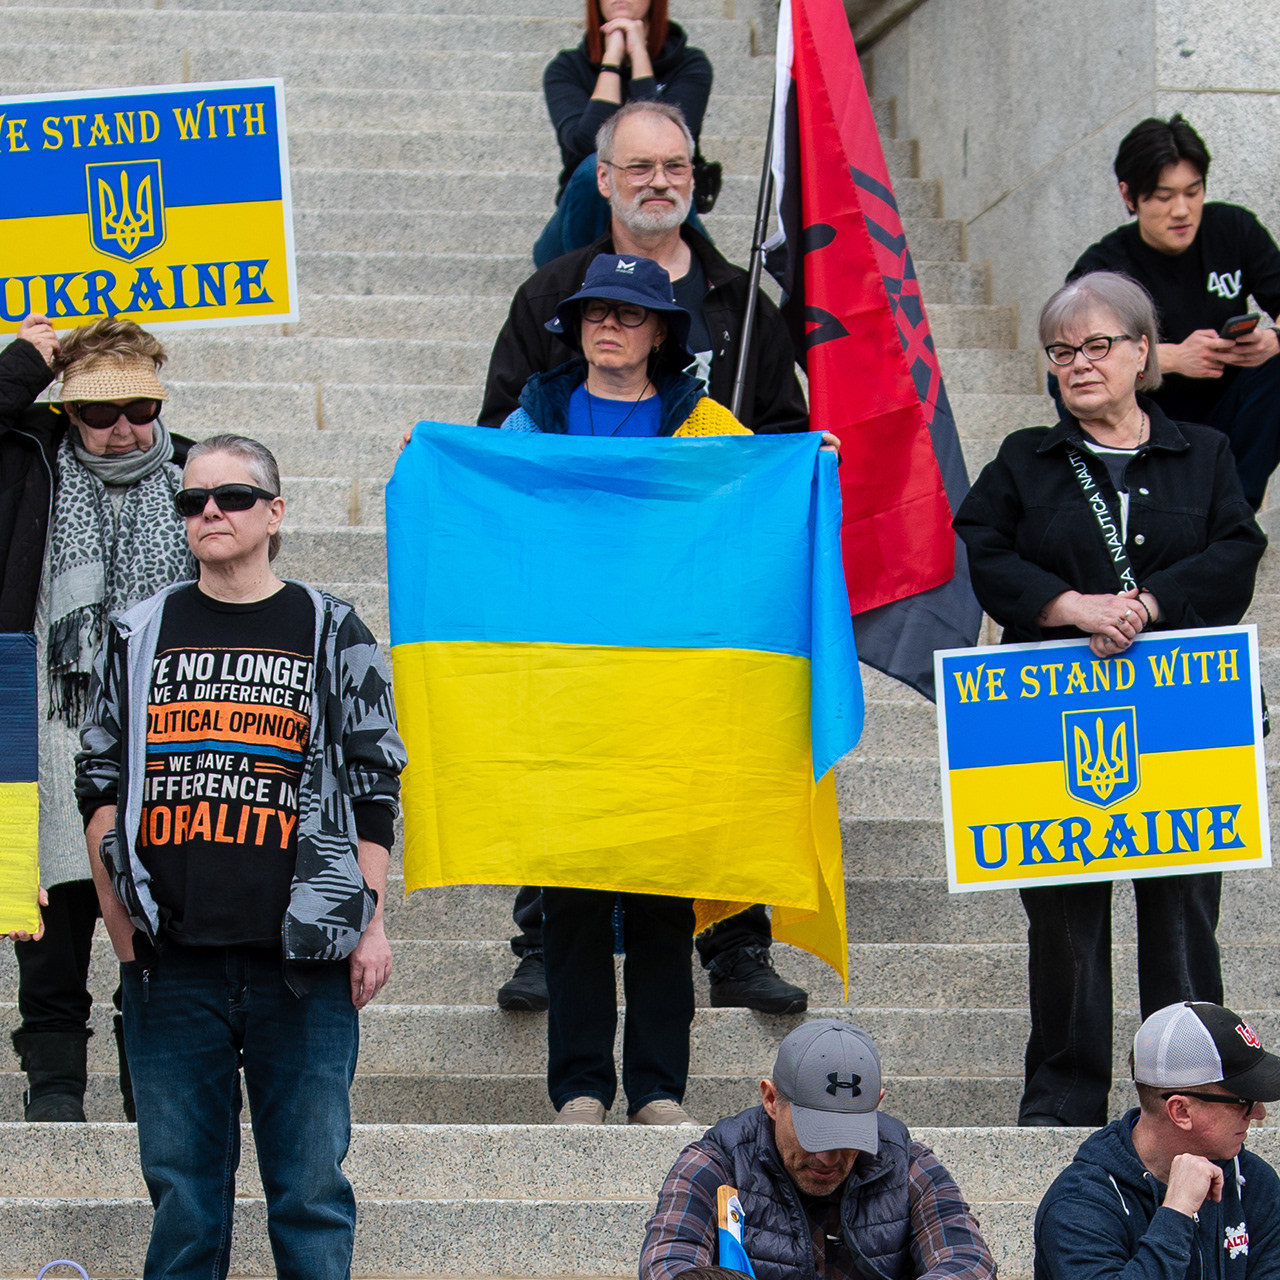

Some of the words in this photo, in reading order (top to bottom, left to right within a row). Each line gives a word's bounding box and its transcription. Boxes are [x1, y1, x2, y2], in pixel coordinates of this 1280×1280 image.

[42, 109, 161, 151] STAND
[171, 98, 268, 140] WITH
[1089, 491, 1127, 563] NAUTICA
[152, 655, 172, 685] E
[176, 653, 215, 681] NO
[953, 662, 1010, 704] WE
[1019, 657, 1137, 700] STAND
[1147, 645, 1241, 688] WITH
[149, 685, 174, 702] VE
[177, 684, 188, 700] A
[194, 683, 293, 707] DIFFERENCE
[146, 709, 224, 735] OLITICAL
[169, 756, 192, 772] WE
[196, 753, 235, 771] HAVE
[239, 757, 249, 772] A
[144, 773, 271, 802] IFFERENCE
[279, 782, 298, 810] IN
[966, 803, 1247, 869] UKRAINE
